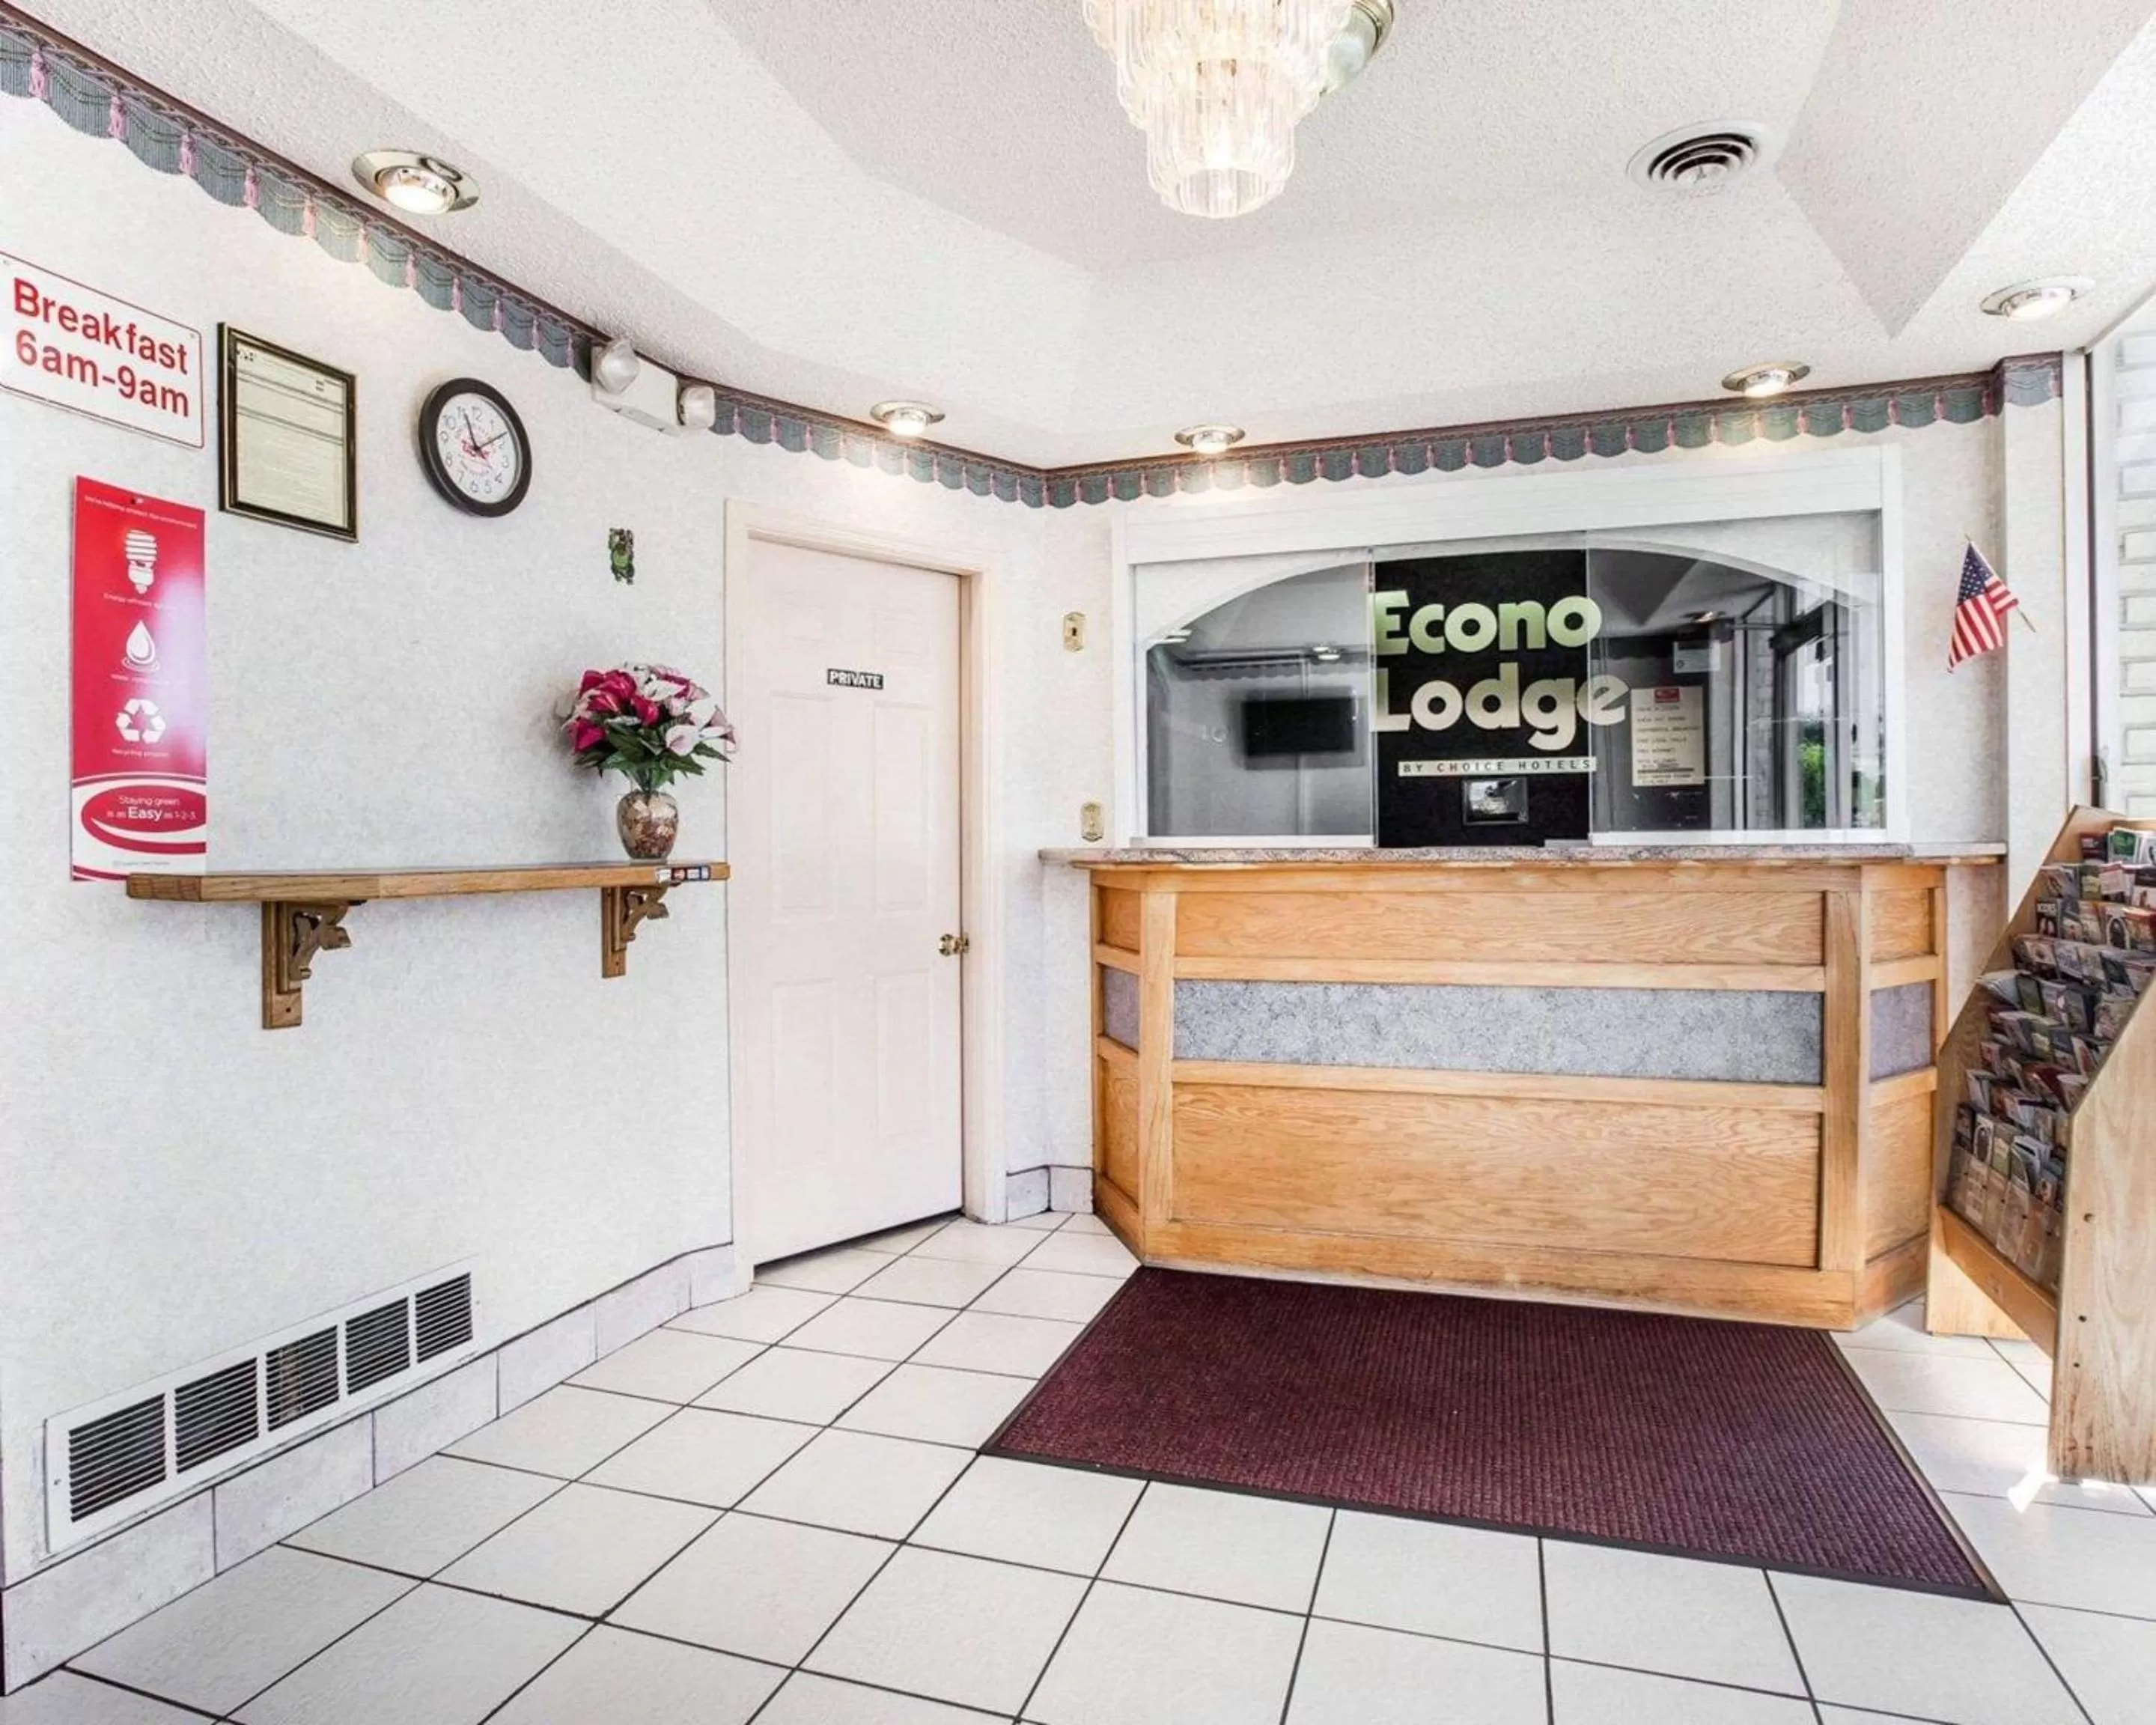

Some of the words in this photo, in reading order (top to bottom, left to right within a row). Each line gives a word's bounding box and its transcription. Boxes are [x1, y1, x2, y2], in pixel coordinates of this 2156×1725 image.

[13, 277, 188, 375] Breakfast
[16, 329, 189, 418] 6am-9am
[1368, 589, 1603, 655] Econo
[829, 670, 882, 688] PRIVATE
[1369, 662, 1630, 751] Lodge
[1402, 764, 1423, 773] BY
[1437, 761, 1506, 773] CHOICE
[1518, 759, 1592, 771] HOTELS
[128, 806, 163, 822] Easy
